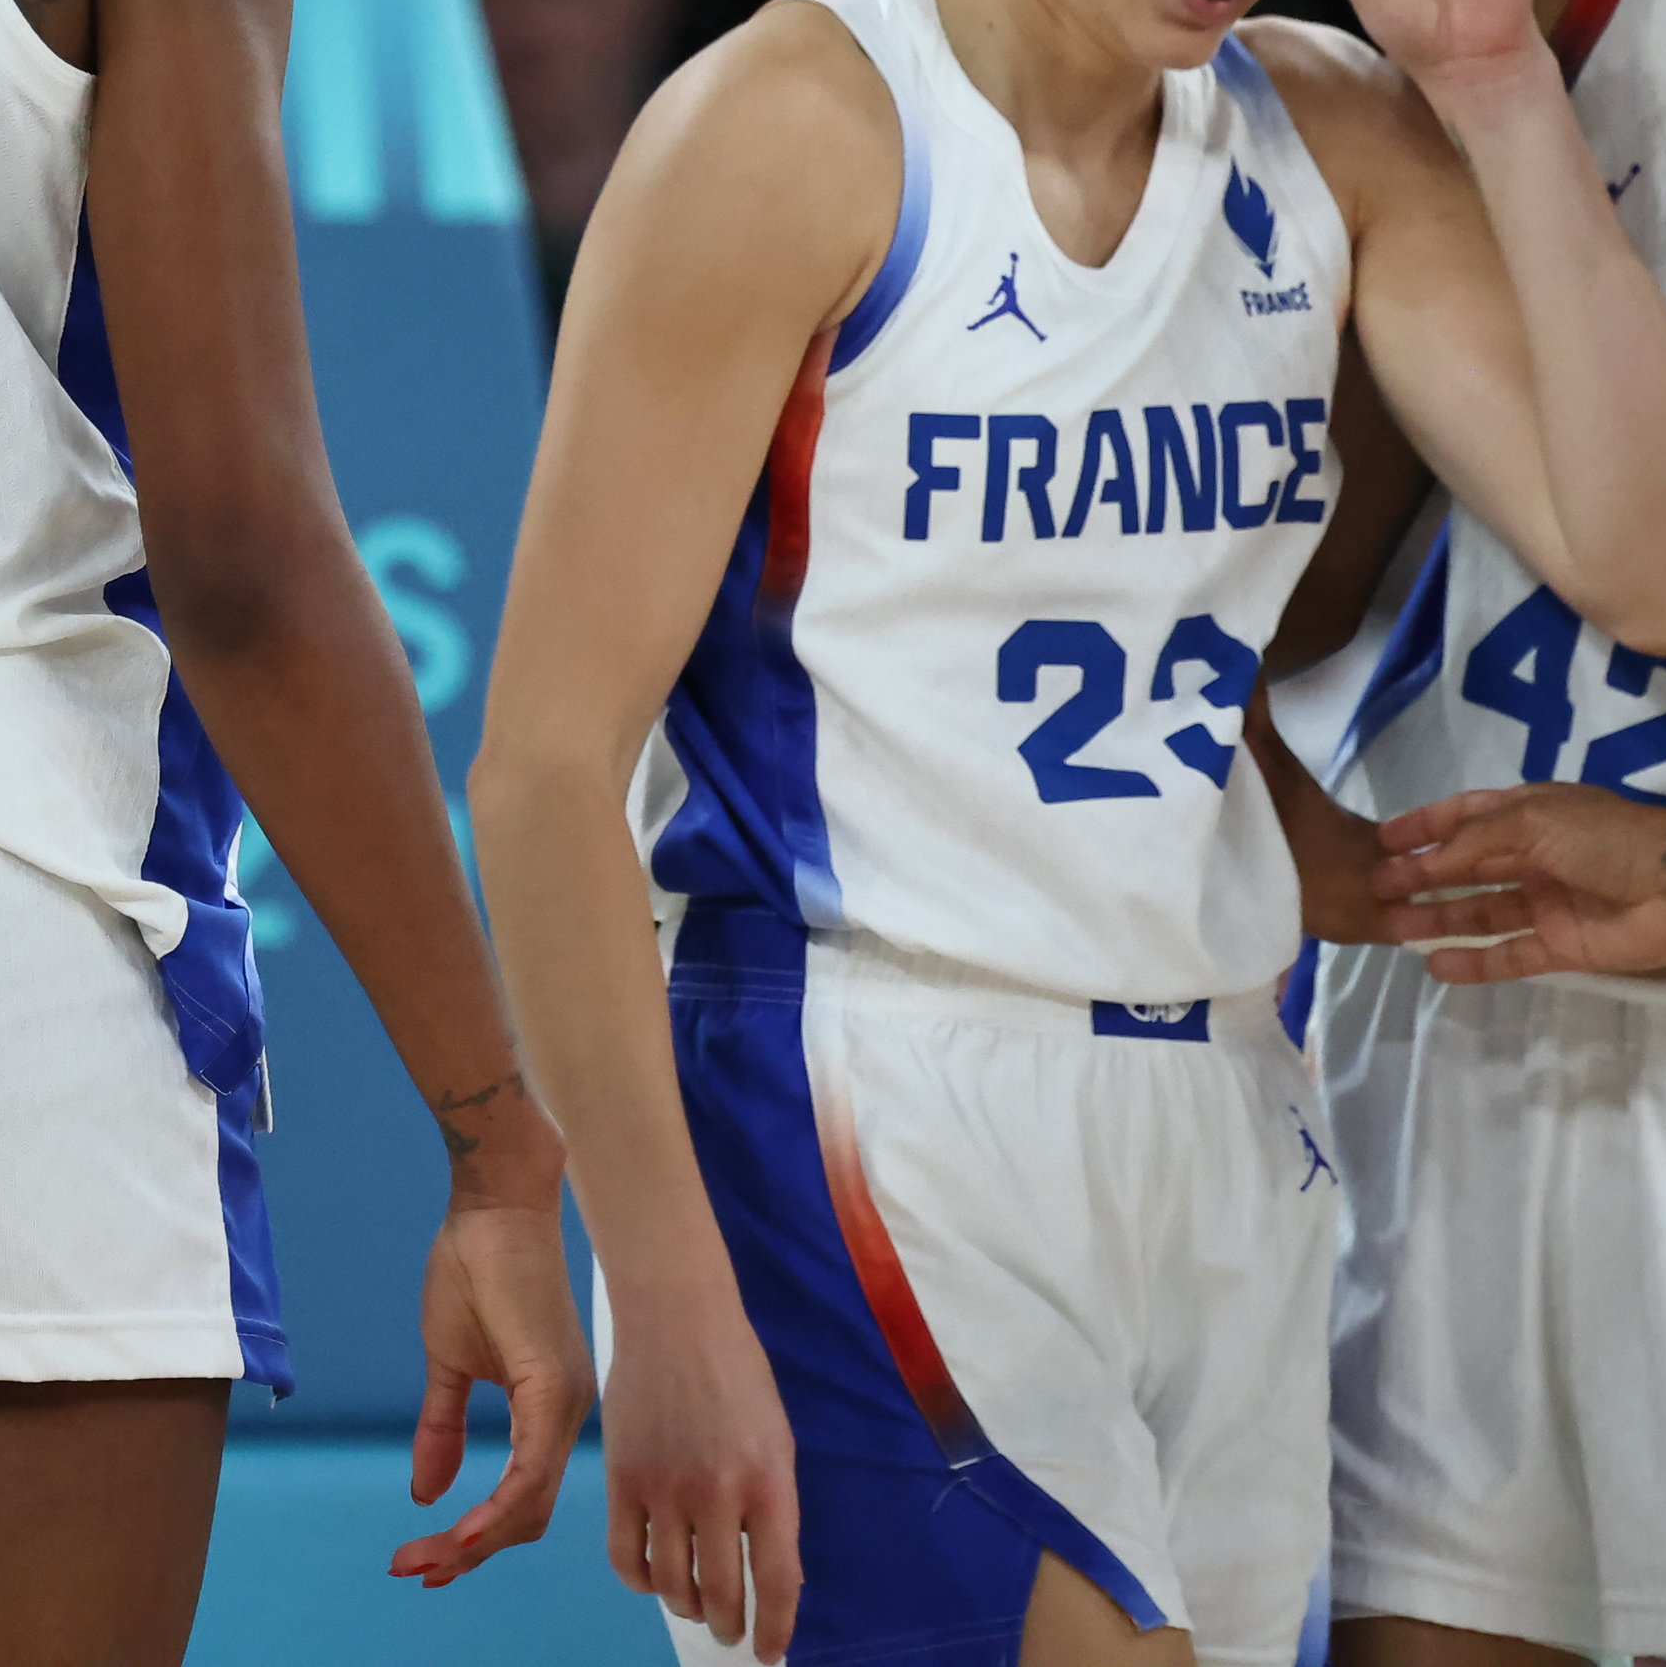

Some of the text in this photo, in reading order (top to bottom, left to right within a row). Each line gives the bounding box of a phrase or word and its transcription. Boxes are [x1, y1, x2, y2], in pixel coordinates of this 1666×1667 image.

[1240, 281, 1313, 316] FRANCE
[904, 398, 1326, 543] FRANCE
[997, 614, 1261, 804] 23
